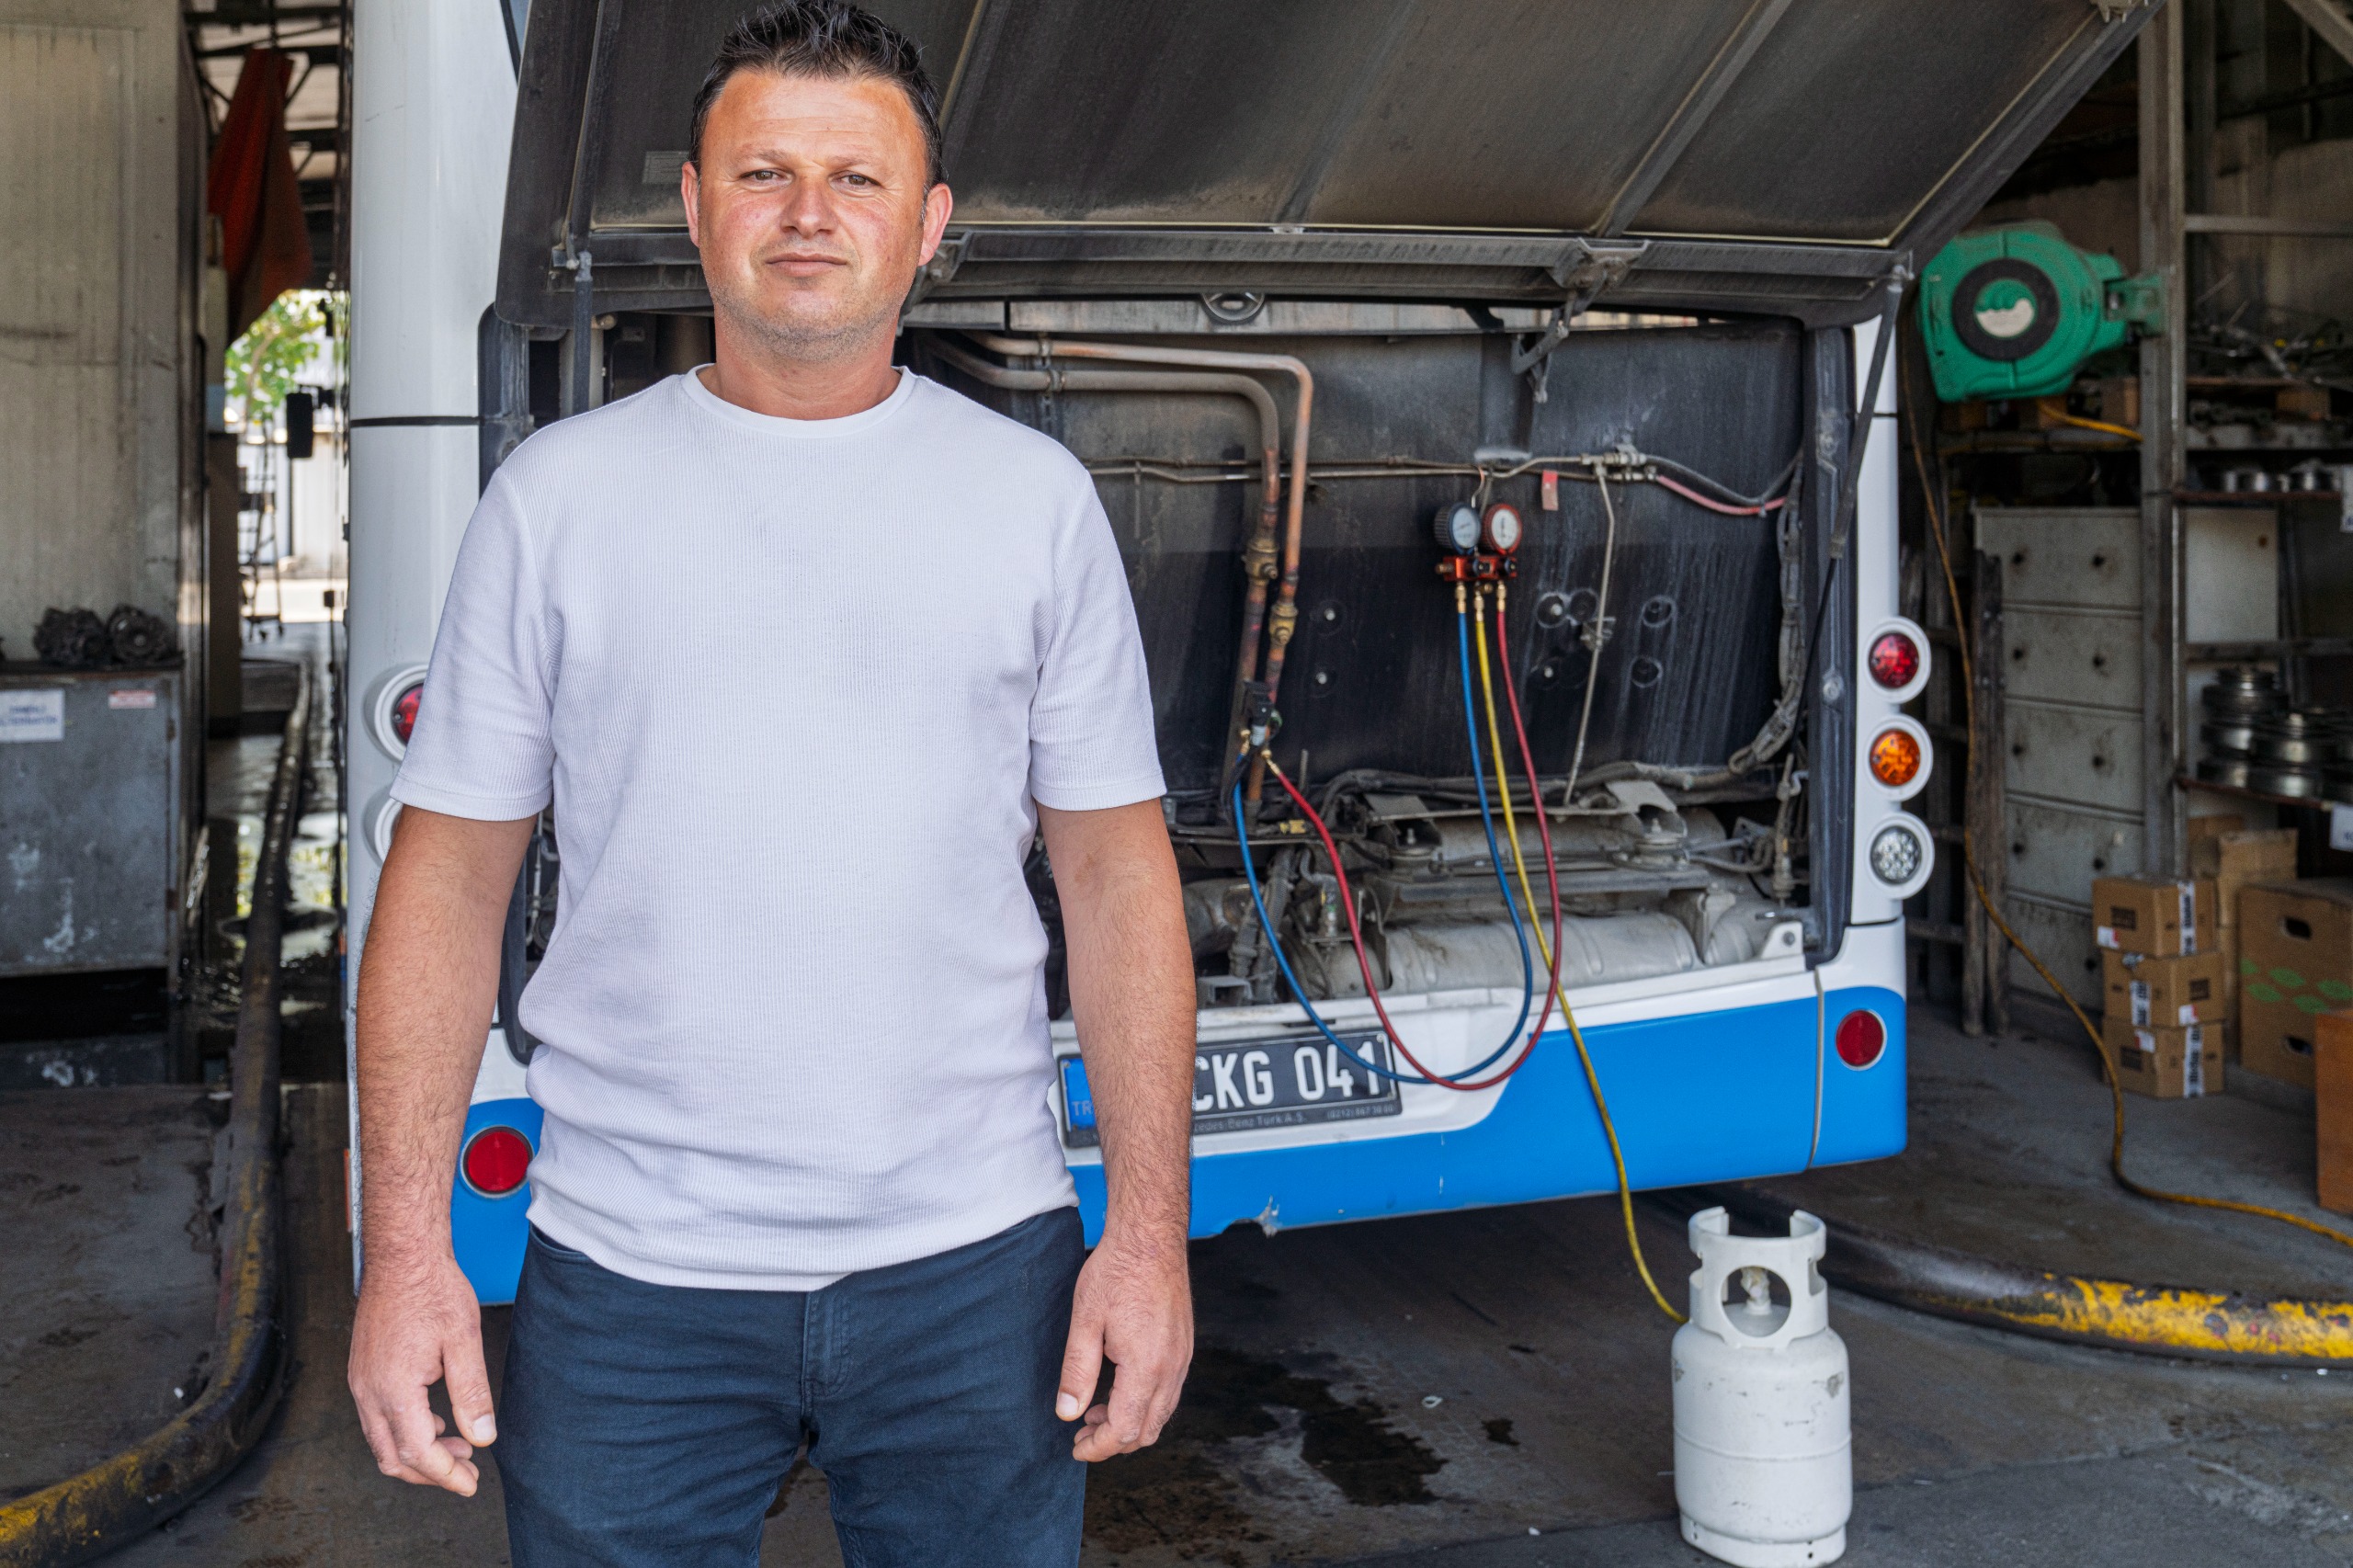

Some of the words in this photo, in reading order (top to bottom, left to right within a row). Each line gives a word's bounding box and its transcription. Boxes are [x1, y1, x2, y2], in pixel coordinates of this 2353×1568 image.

[1193, 1051, 1275, 1111] CKG
[1294, 1040, 1380, 1101] 041
[1072, 1100, 1092, 1116] TR
